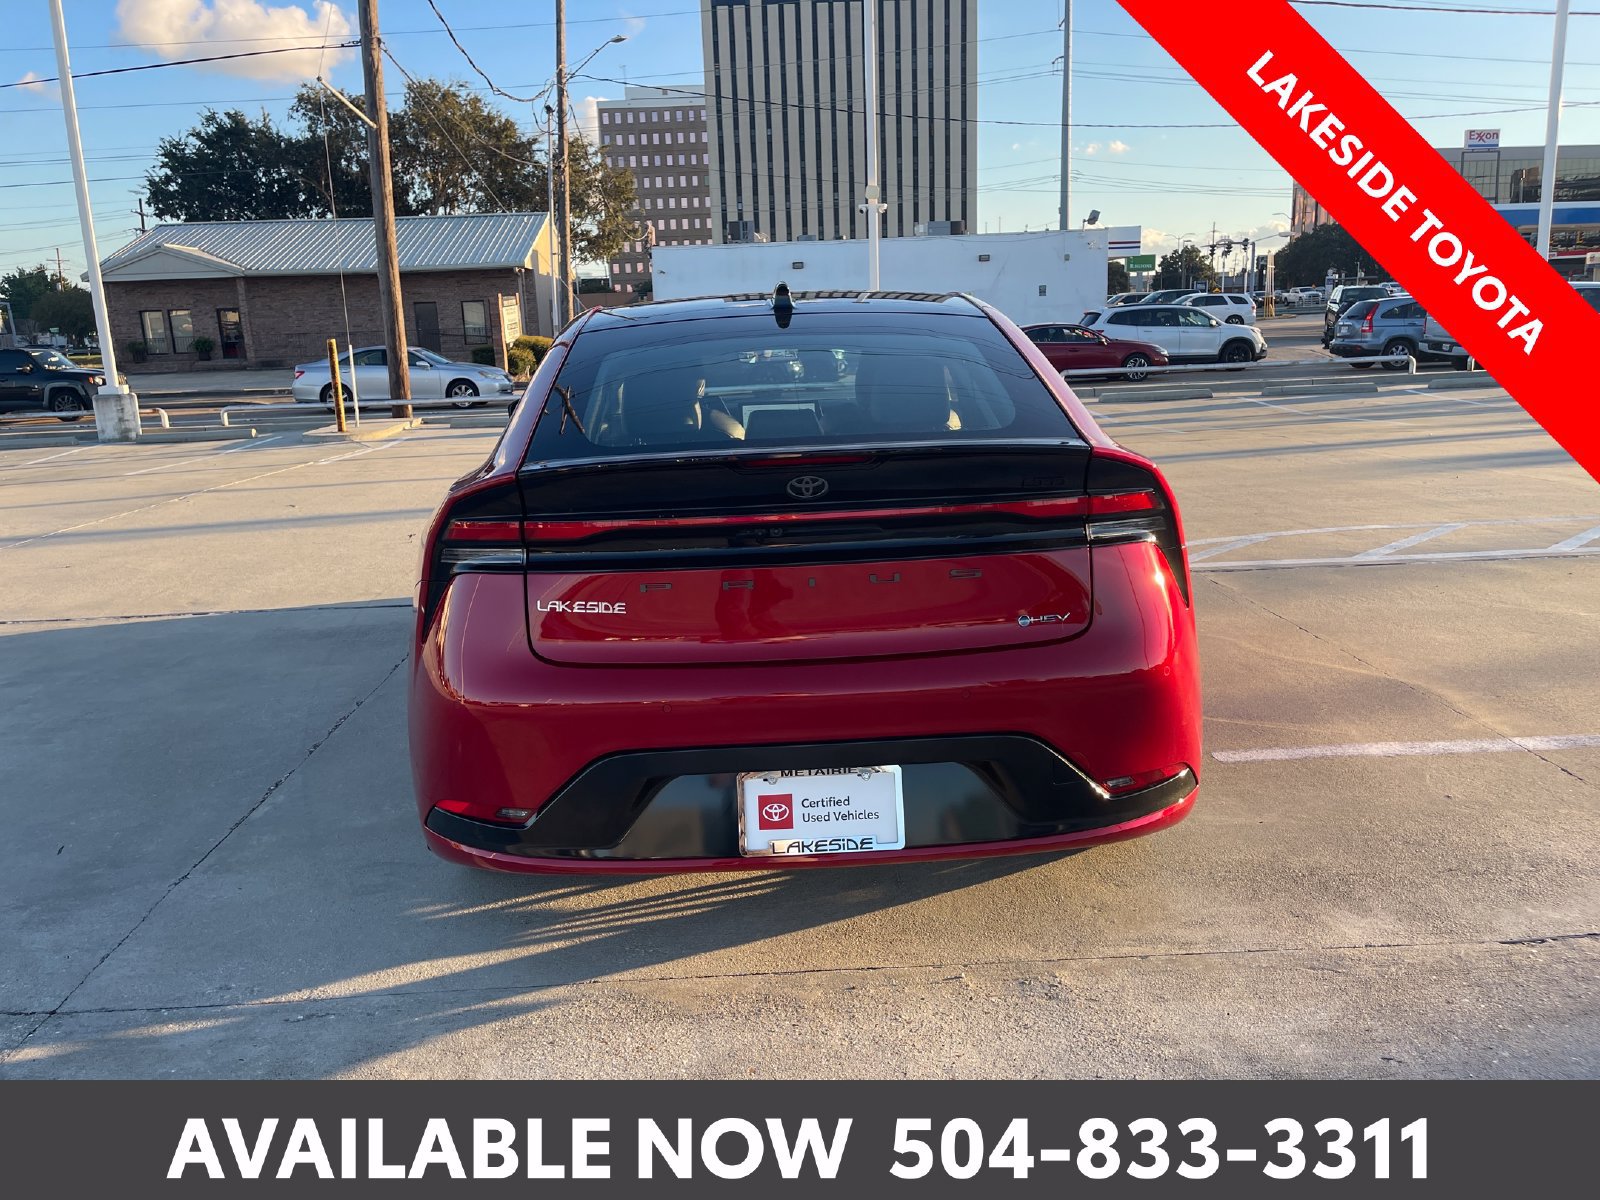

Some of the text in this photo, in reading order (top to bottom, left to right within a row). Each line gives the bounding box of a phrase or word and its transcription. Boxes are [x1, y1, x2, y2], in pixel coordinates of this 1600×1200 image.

[1468, 130, 1499, 143] Exxon
[640, 568, 983, 593] PRIUS
[537, 600, 627, 614] LAKESIDE
[1030, 612, 1070, 624] HEV
[801, 796, 850, 808] Certified
[802, 809, 880, 822] Used Vehicles
